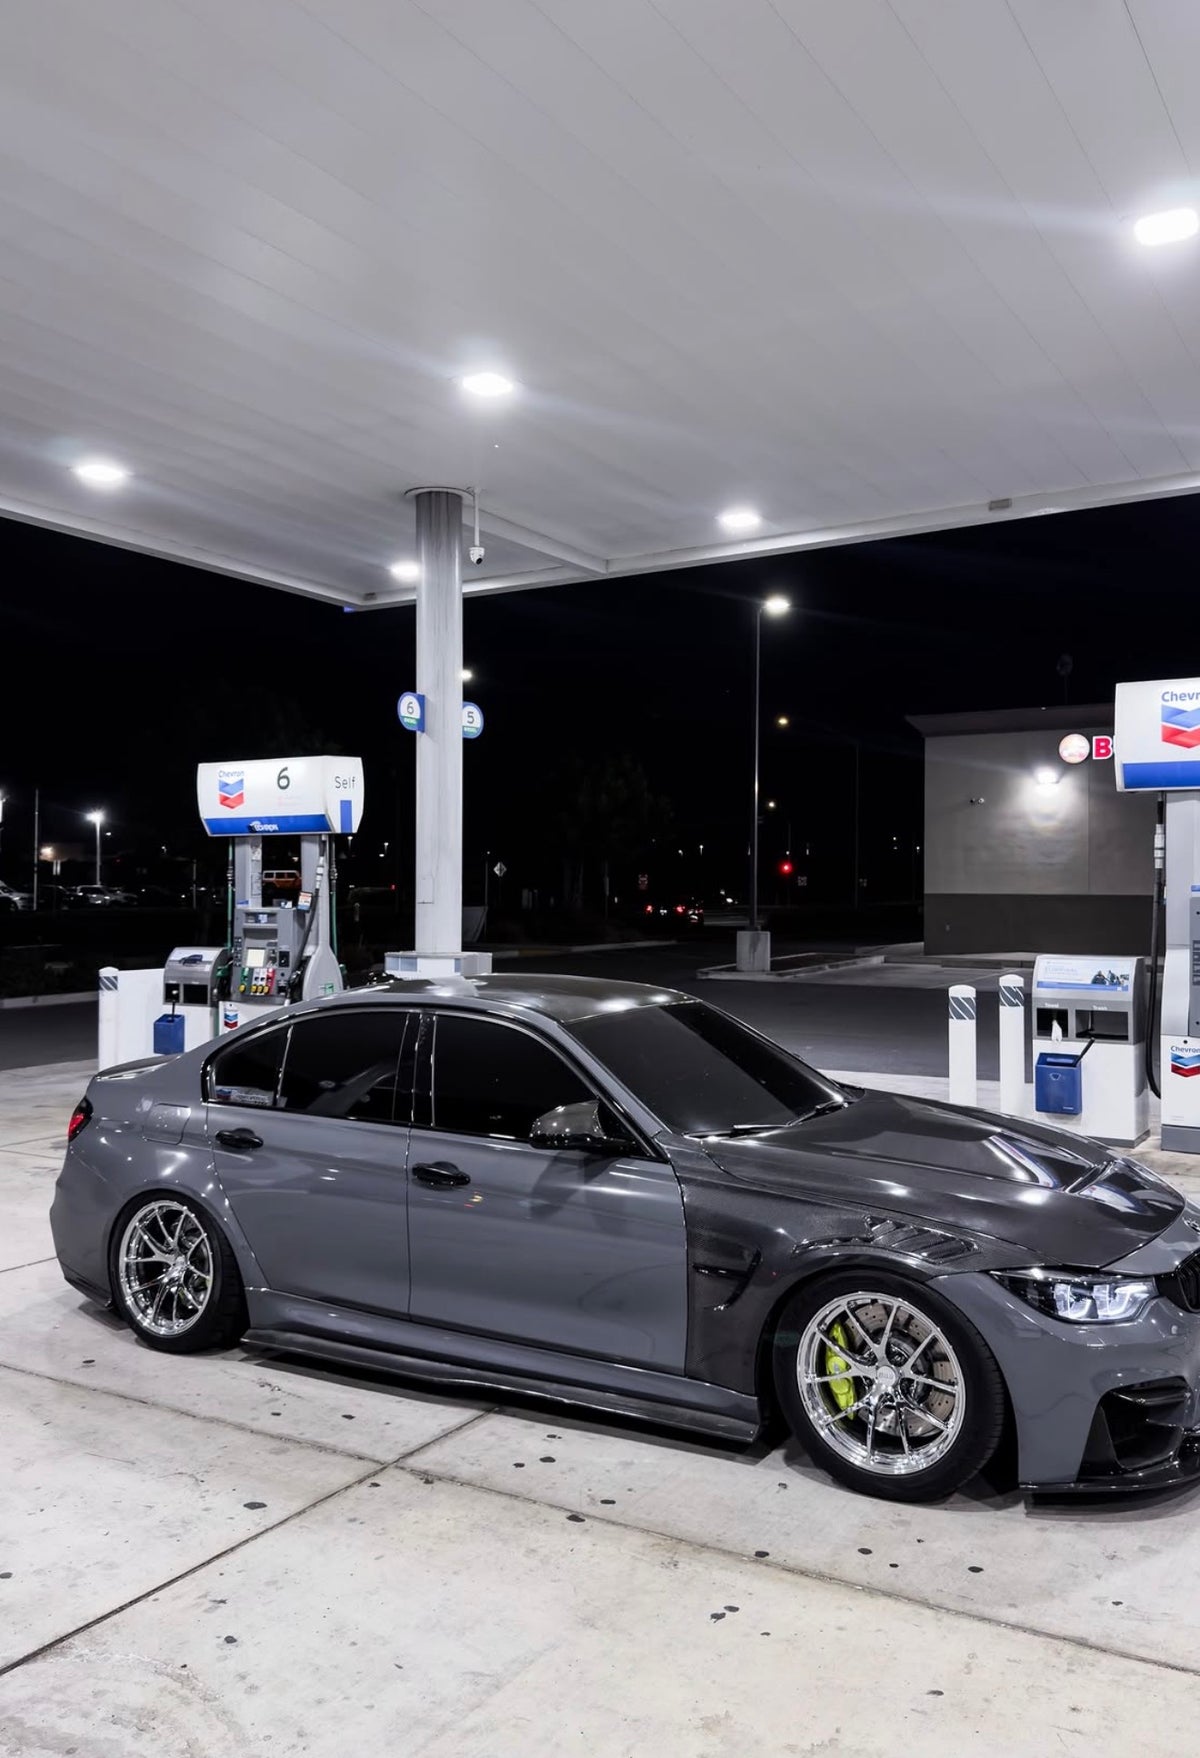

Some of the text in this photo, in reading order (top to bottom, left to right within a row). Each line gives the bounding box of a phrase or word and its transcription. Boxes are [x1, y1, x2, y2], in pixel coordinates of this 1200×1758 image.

[406, 701, 415, 715] 6
[466, 711, 475, 724] 5
[218, 769, 245, 779] Chevron
[276, 766, 290, 790] 6
[334, 775, 356, 789] Self
